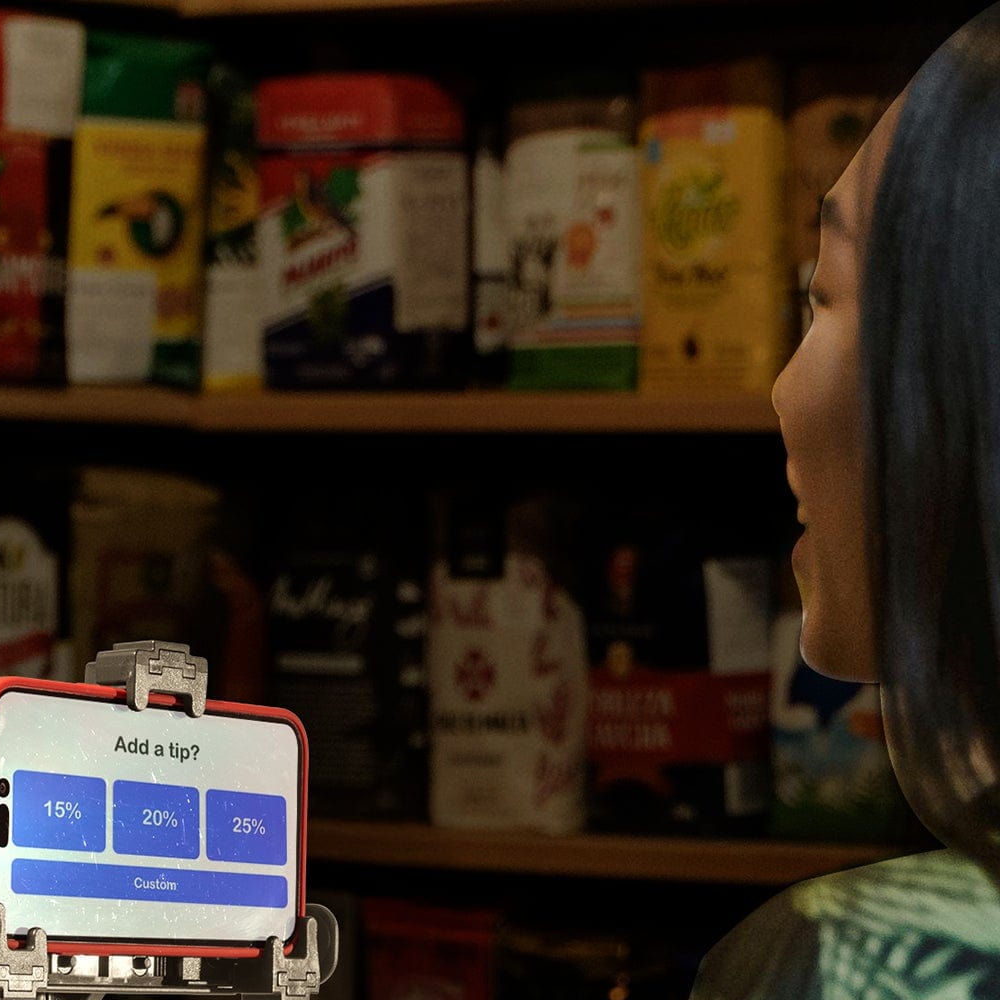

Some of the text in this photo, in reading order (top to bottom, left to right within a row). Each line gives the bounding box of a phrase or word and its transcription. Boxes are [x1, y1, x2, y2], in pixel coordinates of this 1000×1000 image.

[114, 735, 201, 764] Add a tip?
[43, 799, 83, 820] 15%
[142, 808, 179, 828] 20%
[232, 816, 267, 836] 25%
[133, 876, 178, 891] Custom
